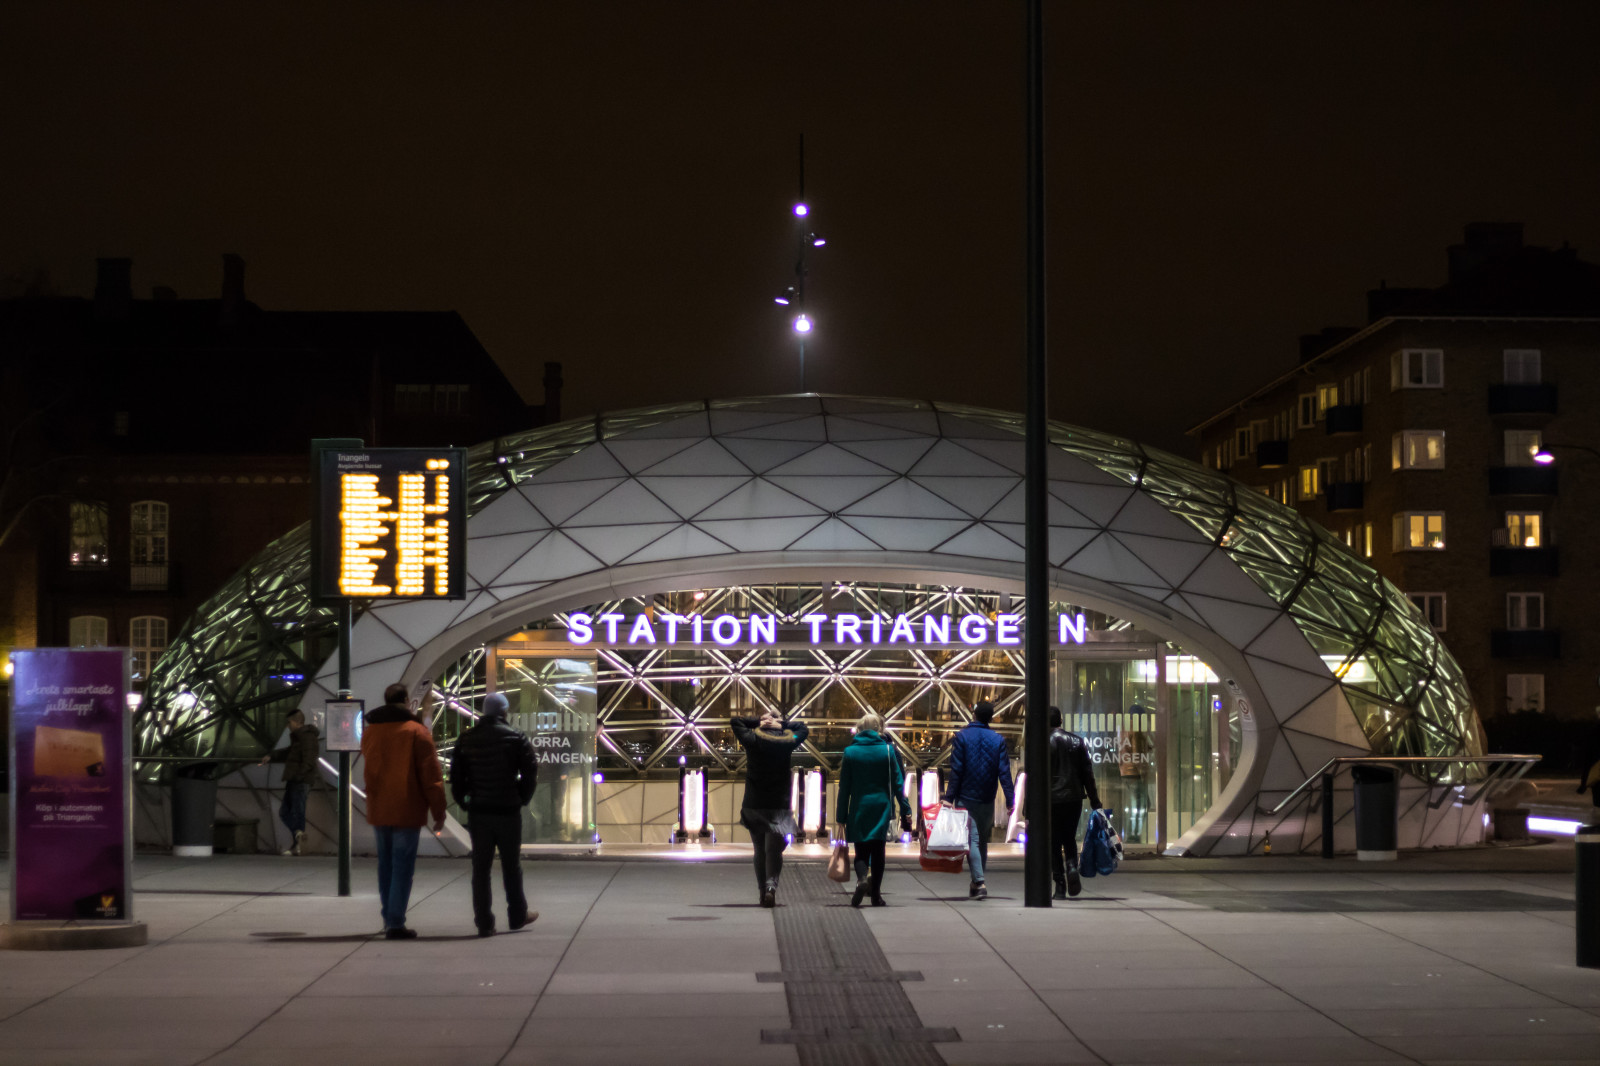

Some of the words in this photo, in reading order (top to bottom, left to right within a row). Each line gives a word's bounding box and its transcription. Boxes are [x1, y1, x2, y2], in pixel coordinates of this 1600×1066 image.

[337, 454, 370, 463] Triangeln
[567, 612, 777, 646] STATION
[803, 612, 1086, 646] TRIANGEN
[62, 684, 115, 695] smartaste
[43, 697, 95, 716] julklapp!
[528, 736, 571, 748] ORRA
[1084, 736, 1132, 748] NORRA
[35, 803, 52, 813] Köp
[59, 804, 104, 812] automaten
[43, 813, 54, 822] på
